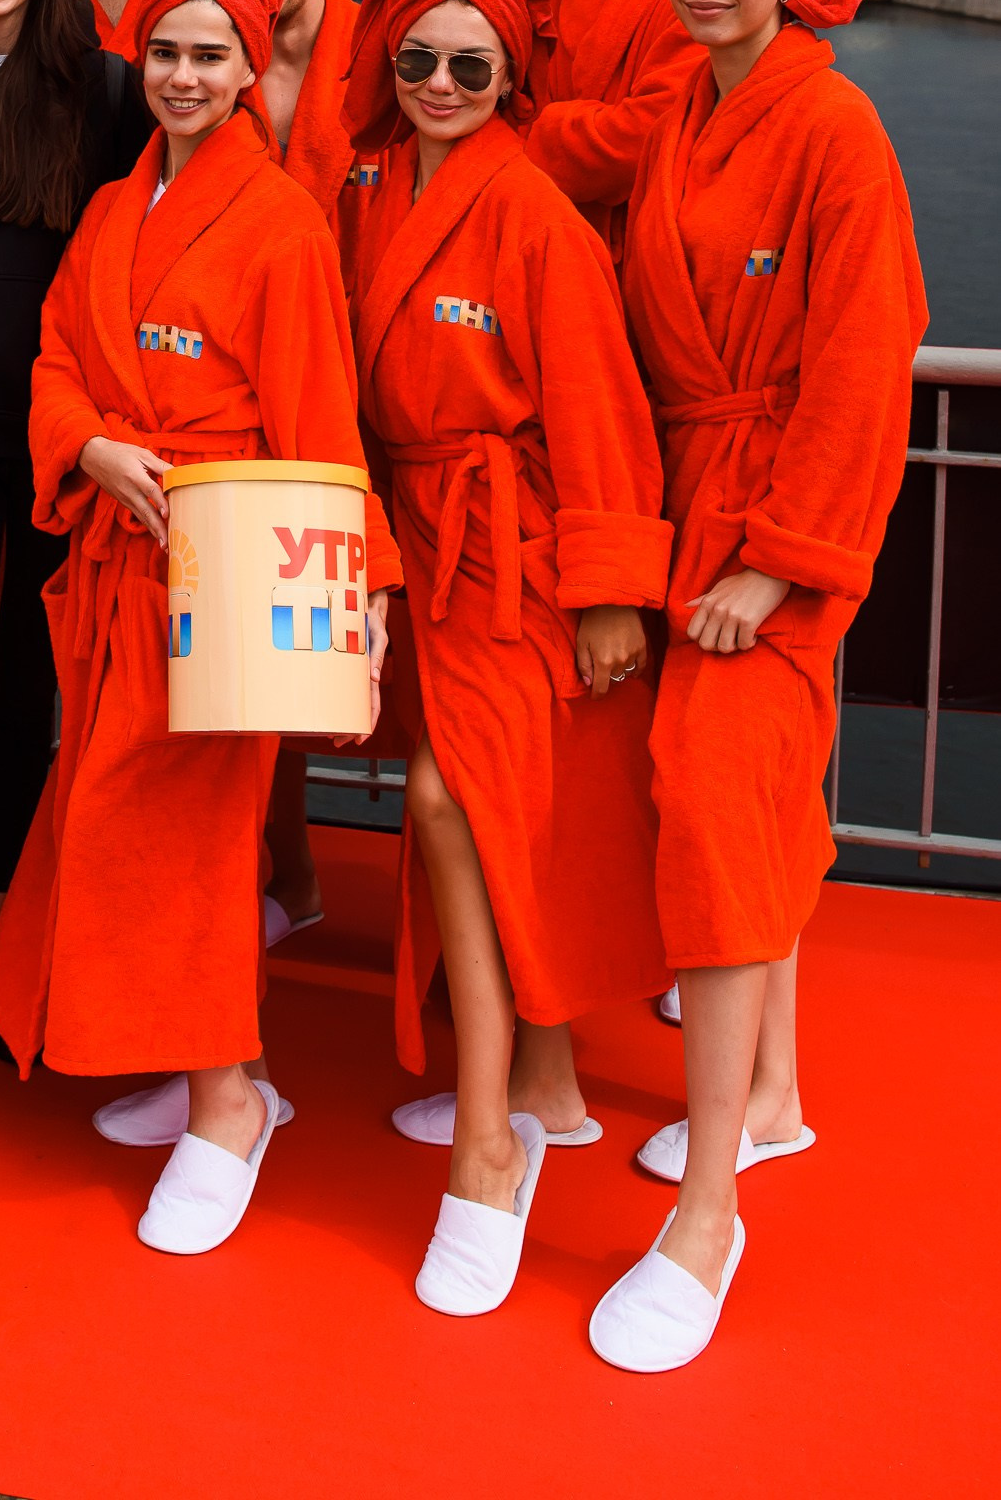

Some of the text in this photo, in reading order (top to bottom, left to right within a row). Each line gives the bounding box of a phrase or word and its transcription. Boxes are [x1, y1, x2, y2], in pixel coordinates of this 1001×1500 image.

[434, 295, 502, 337] ТНТ
[138, 322, 203, 359] ТНТ
[271, 585, 369, 656] ТН
